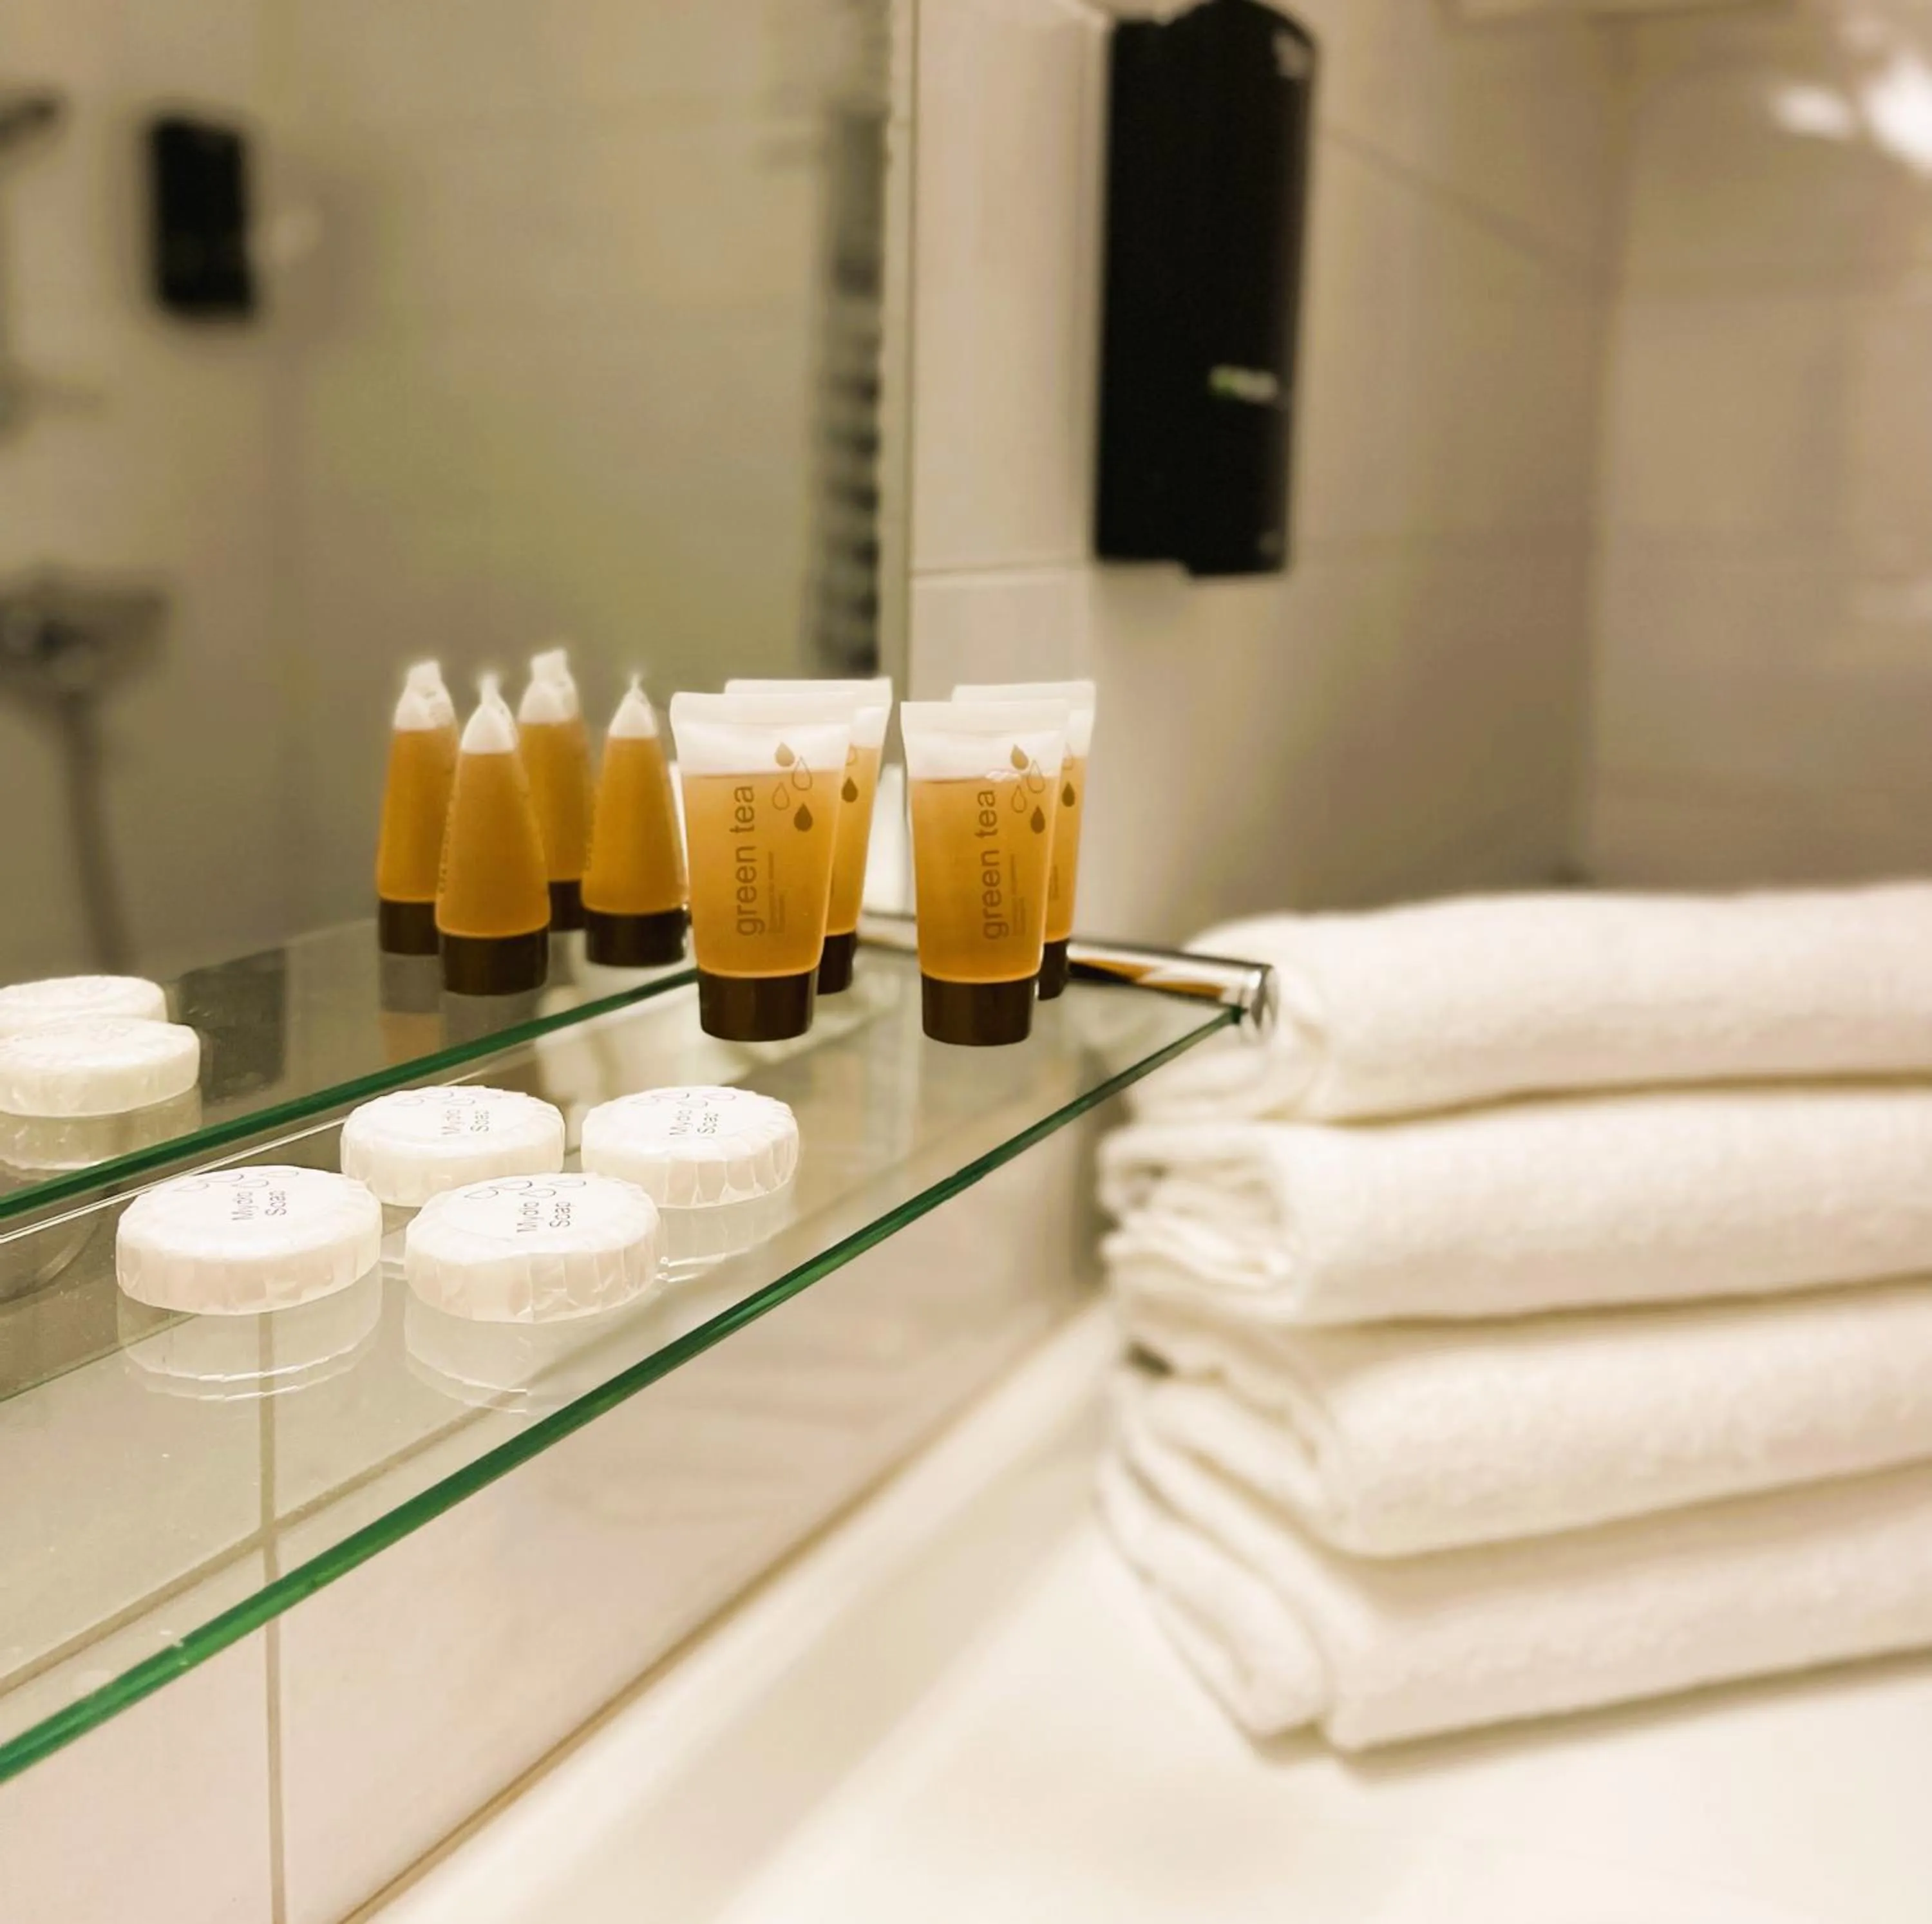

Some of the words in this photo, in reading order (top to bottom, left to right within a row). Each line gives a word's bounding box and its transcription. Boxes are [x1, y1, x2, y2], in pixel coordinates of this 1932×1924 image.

[729, 786, 755, 833] tea
[974, 789, 998, 839] tea
[735, 845, 766, 937] green
[980, 849, 1009, 940] green
